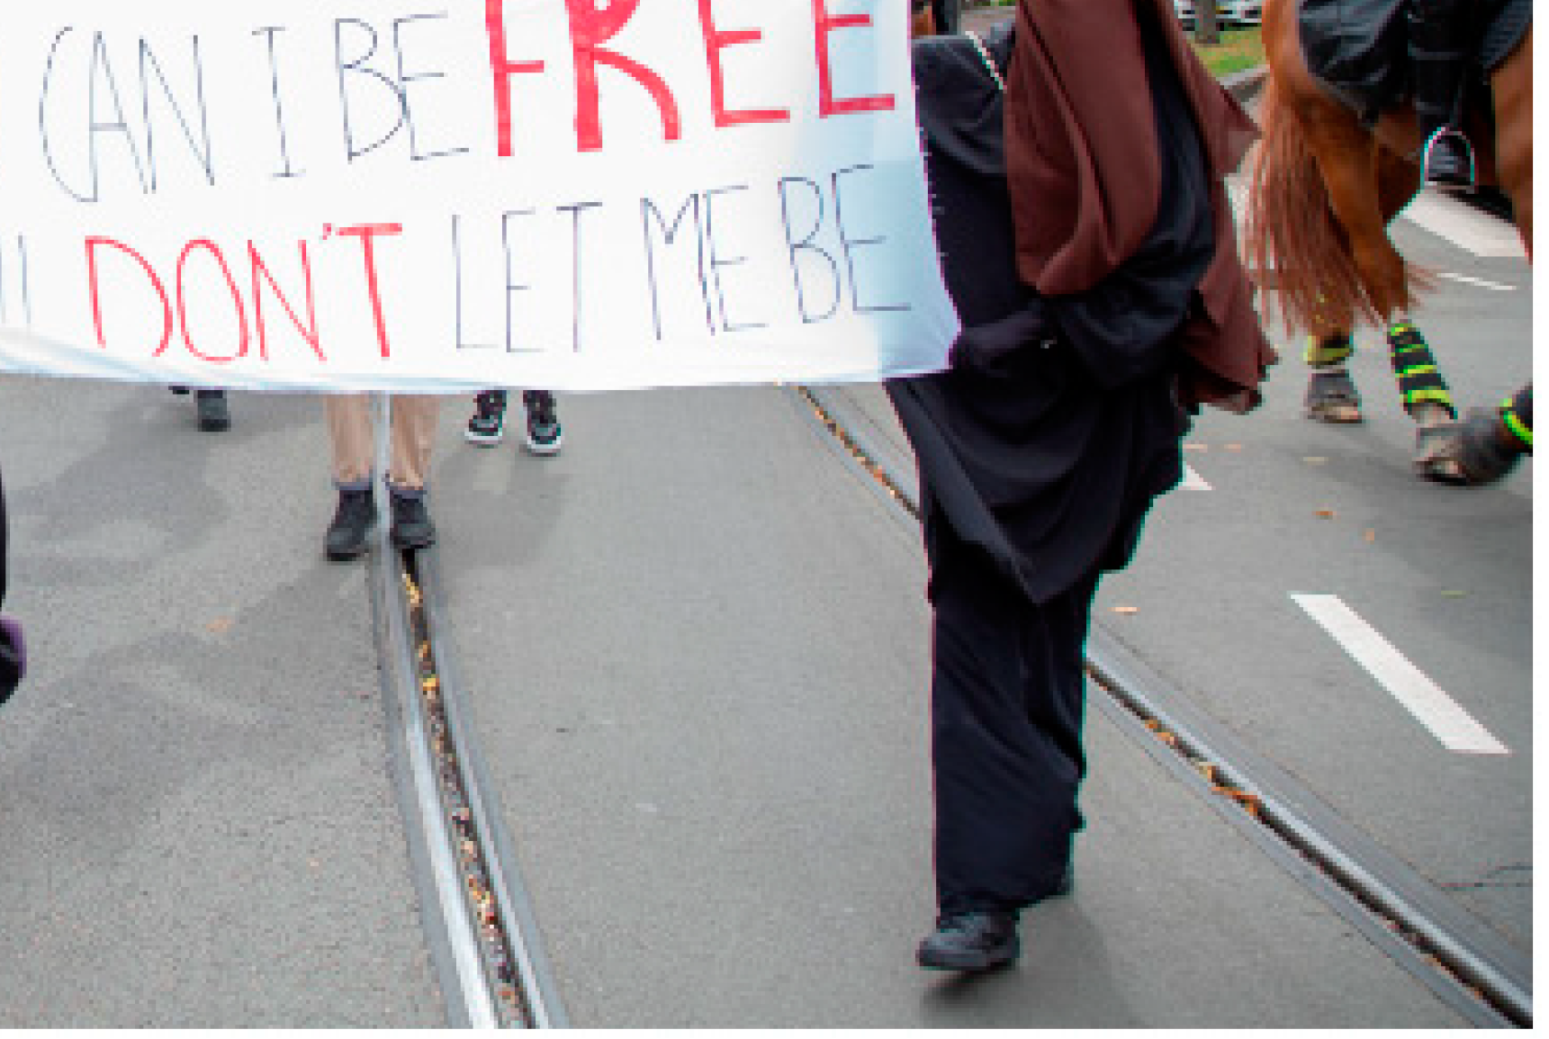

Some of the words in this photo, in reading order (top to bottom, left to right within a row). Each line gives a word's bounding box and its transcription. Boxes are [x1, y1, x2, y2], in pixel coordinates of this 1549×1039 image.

[39, 26, 216, 203] CAN
[251, 26, 306, 178] I
[335, 14, 469, 163] BE
[85, 222, 403, 363] DON'T
[452, 202, 603, 353] LET
[640, 185, 767, 339] ME
[777, 164, 912, 323] BE
